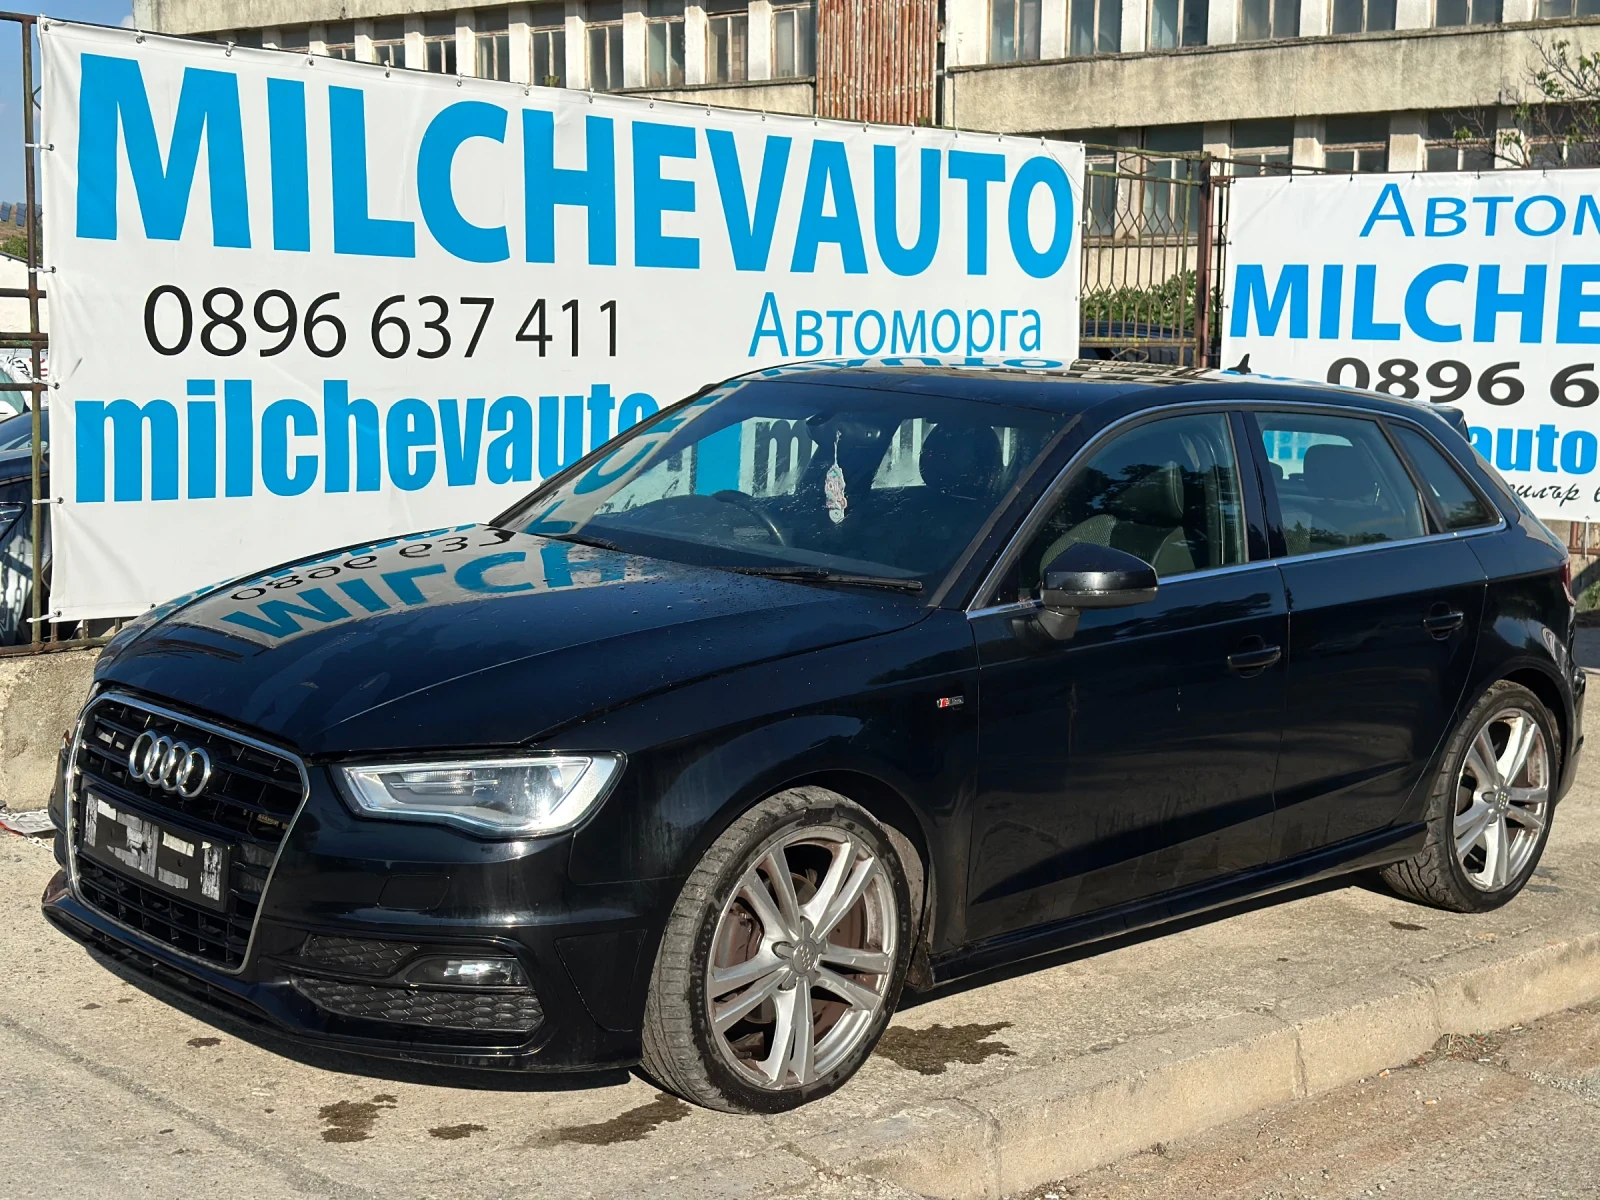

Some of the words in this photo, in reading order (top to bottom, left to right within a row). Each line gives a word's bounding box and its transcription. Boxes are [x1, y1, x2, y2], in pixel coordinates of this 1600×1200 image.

[76, 52, 1074, 279] MILCHEVAUTO
[144, 284, 347, 358] 0896
[371, 294, 495, 359] 637
[515, 298, 617, 357] 411
[748, 291, 1041, 357] Автоморга
[1229, 263, 1600, 344] MILCHE
[1326, 357, 1525, 406] 0896
